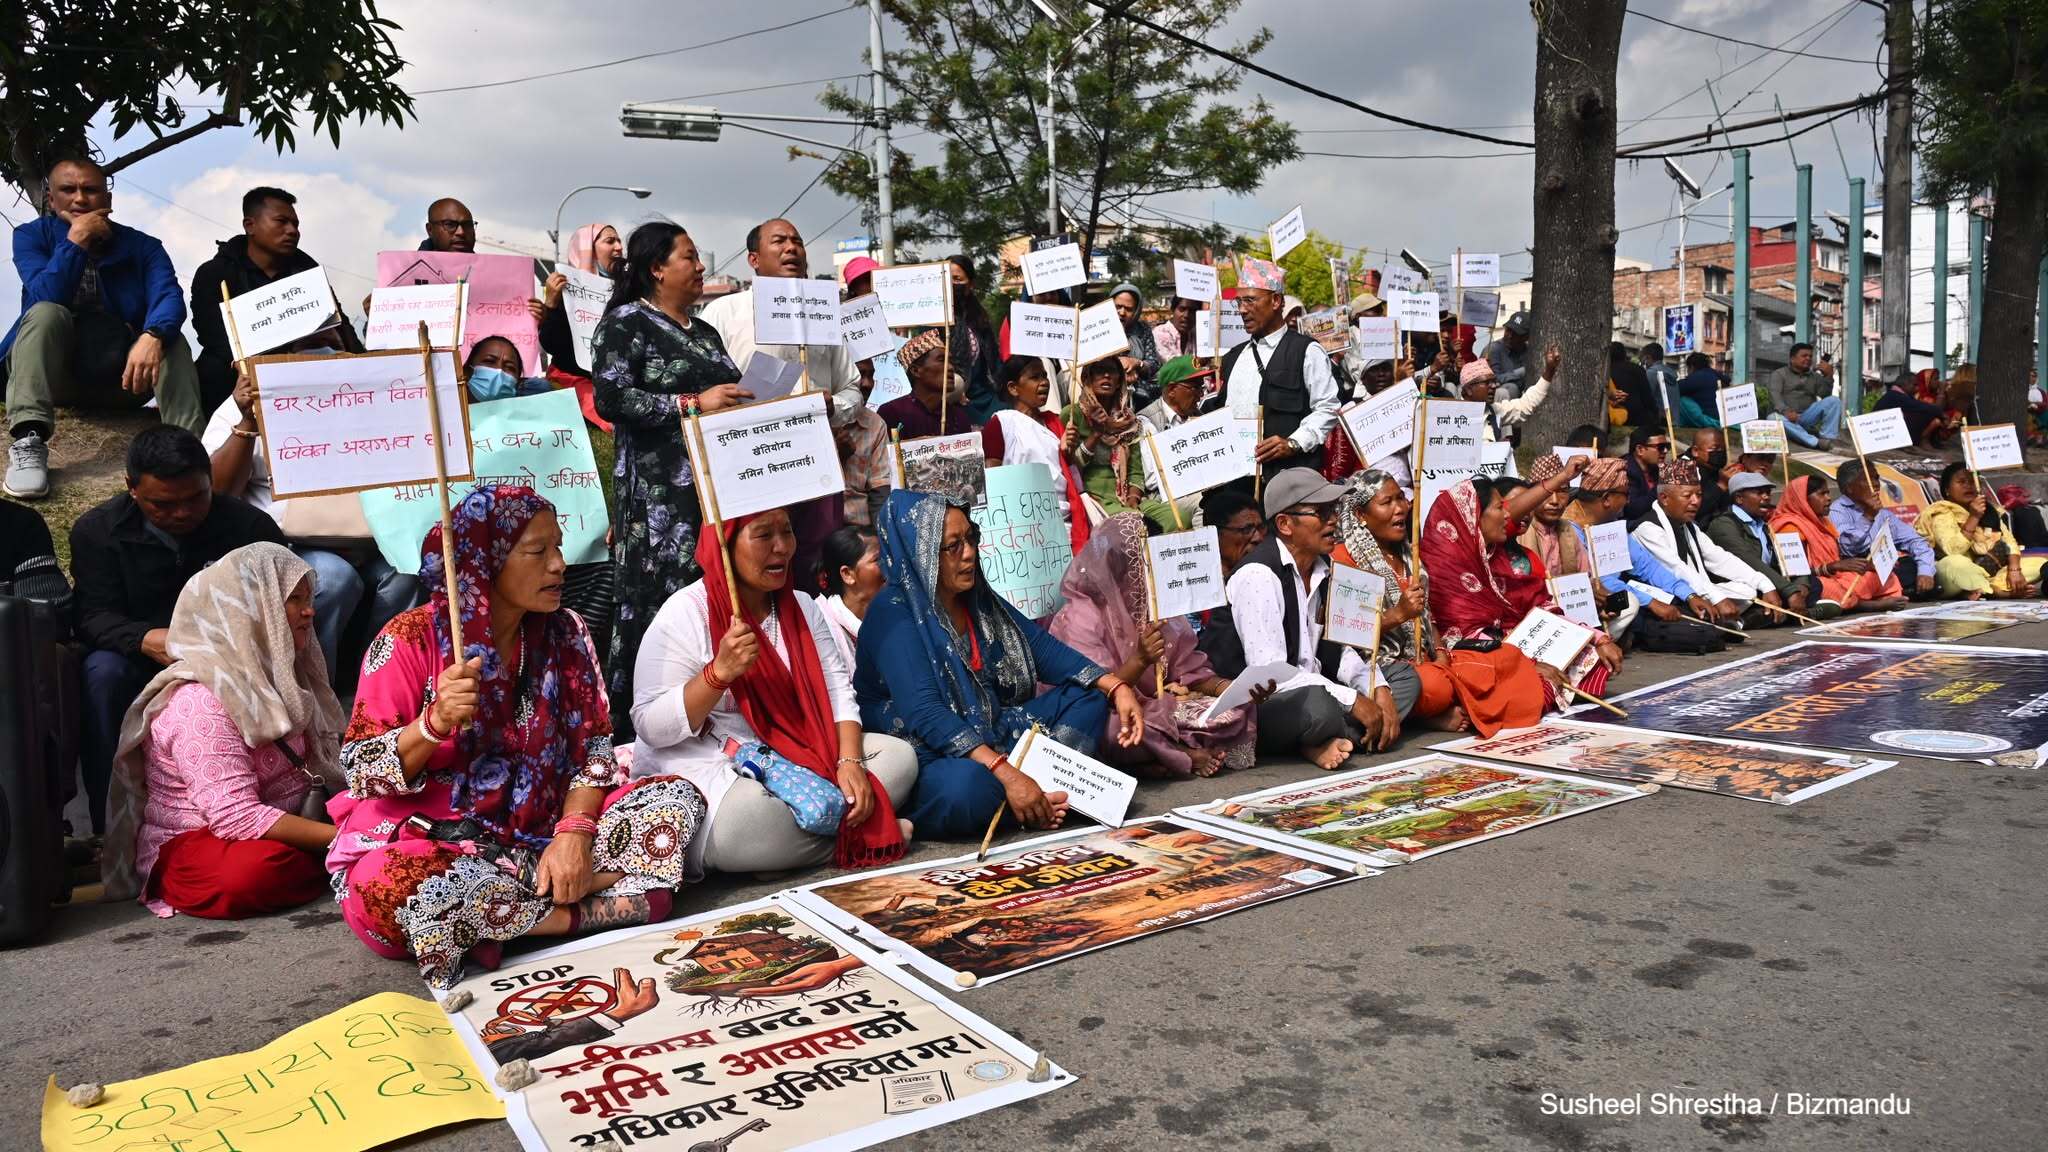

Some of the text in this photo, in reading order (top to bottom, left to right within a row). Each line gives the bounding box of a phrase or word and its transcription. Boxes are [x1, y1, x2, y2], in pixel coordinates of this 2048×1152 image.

[716, 429, 748, 446] सुरक्षित
[1170, 426, 1224, 454] भूमि अधिकार
[738, 468, 764, 481] जमिन
[961, 855, 1130, 898] छैन जीवन
[490, 964, 575, 992] STOP
[719, 1007, 814, 1040] बन्द
[808, 989, 900, 1017] गर,
[560, 1010, 920, 1119] भूमि र आवासको
[744, 1049, 919, 1110] सुनिश्चित
[908, 1033, 987, 1060] गर।
[890, 1074, 932, 1086] अधिकार
